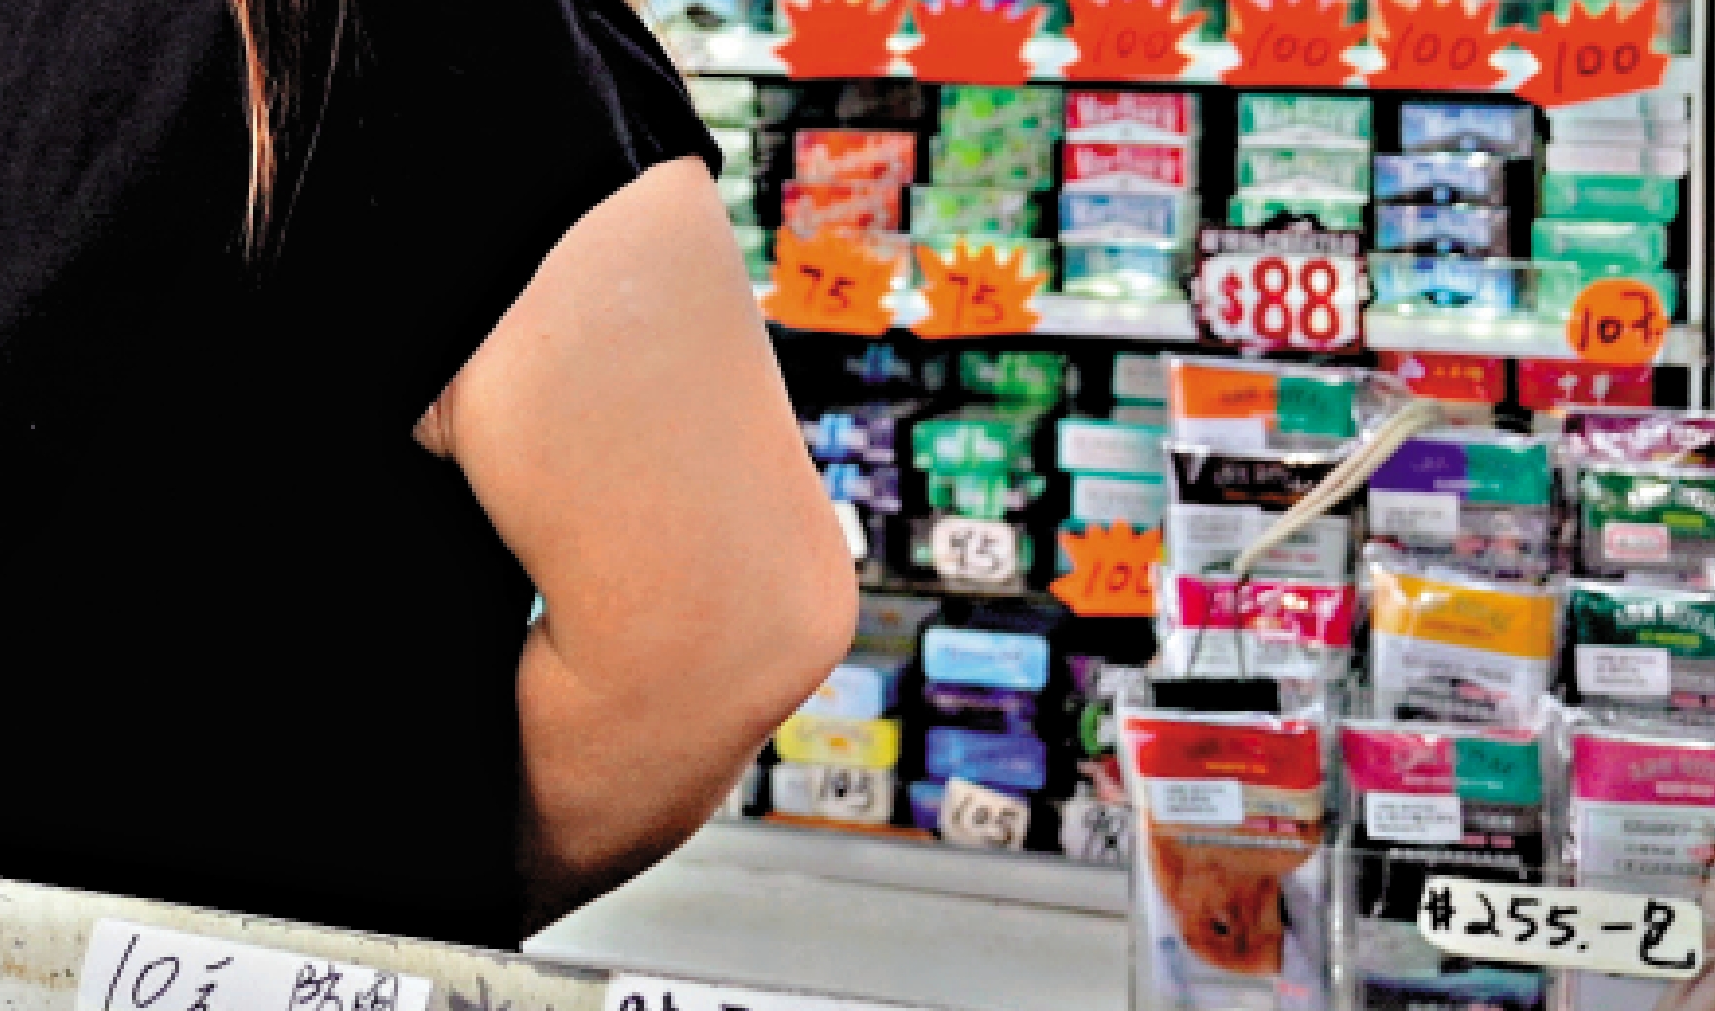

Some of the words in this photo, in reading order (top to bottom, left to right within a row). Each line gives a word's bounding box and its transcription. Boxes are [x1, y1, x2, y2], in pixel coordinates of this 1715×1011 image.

[1091, 21, 1171, 64] 100
[1248, 22, 1332, 71] 100
[1389, 22, 1480, 71] 100
[1553, 40, 1641, 94] 100
[798, 262, 855, 315] 75
[947, 271, 1005, 330] 75
[1220, 257, 1341, 340] $88
